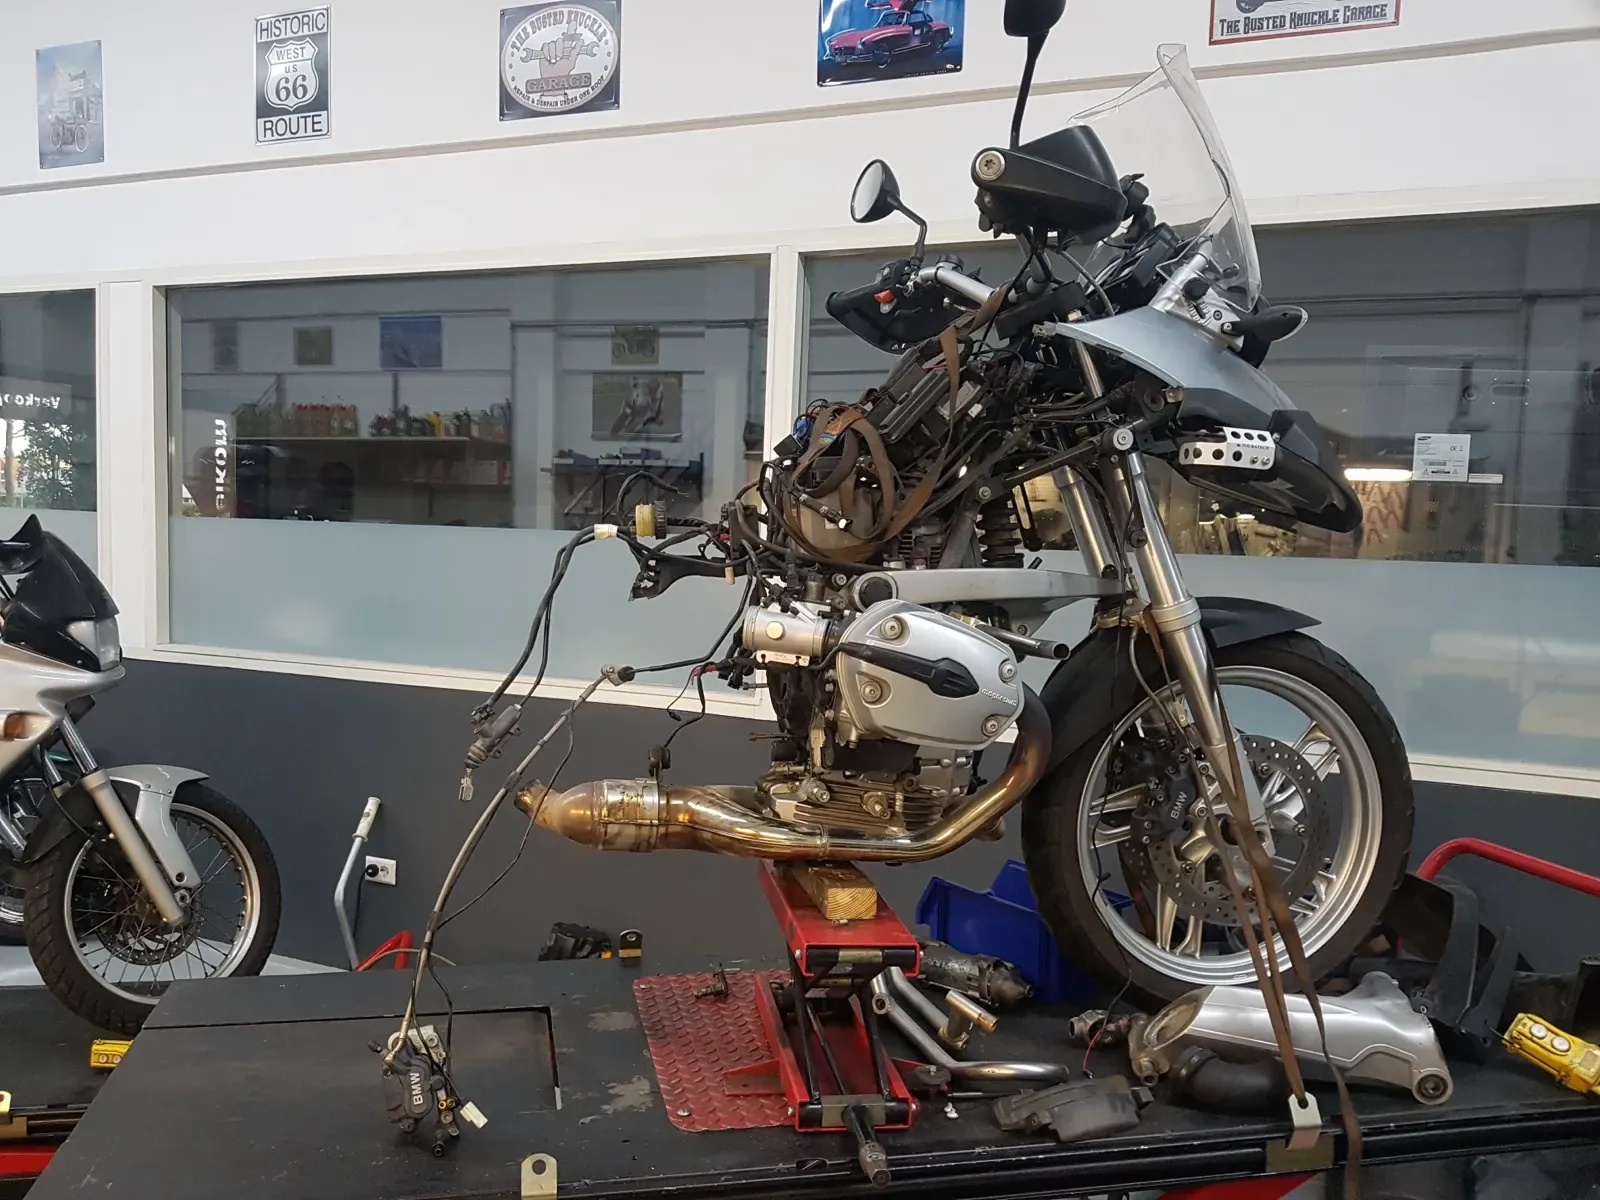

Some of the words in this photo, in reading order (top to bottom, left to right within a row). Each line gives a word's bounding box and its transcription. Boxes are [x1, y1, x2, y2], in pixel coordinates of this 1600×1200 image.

[259, 12, 326, 40] HISTORIC
[510, 28, 531, 52] THE
[529, 10, 565, 34] BUSTED
[566, 9, 608, 43] KNUCKLE
[1243, 14, 1286, 34] BUSTED
[1289, 9, 1340, 29] KNUCKLE
[1343, 4, 1388, 24] GARAGE
[276, 46, 306, 61] WEST
[275, 74, 308, 102] 66
[513, 85, 530, 102] REPAIR
[536, 99, 559, 108] DESPAIR
[559, 96, 578, 107] UNDER
[578, 90, 590, 100] ONE
[591, 75, 605, 92] ROOF
[527, 74, 591, 92] GARAGE
[263, 114, 323, 139] ROUTE
[1170, 791, 1187, 819] BMW
[409, 1072, 424, 1105] BMW
